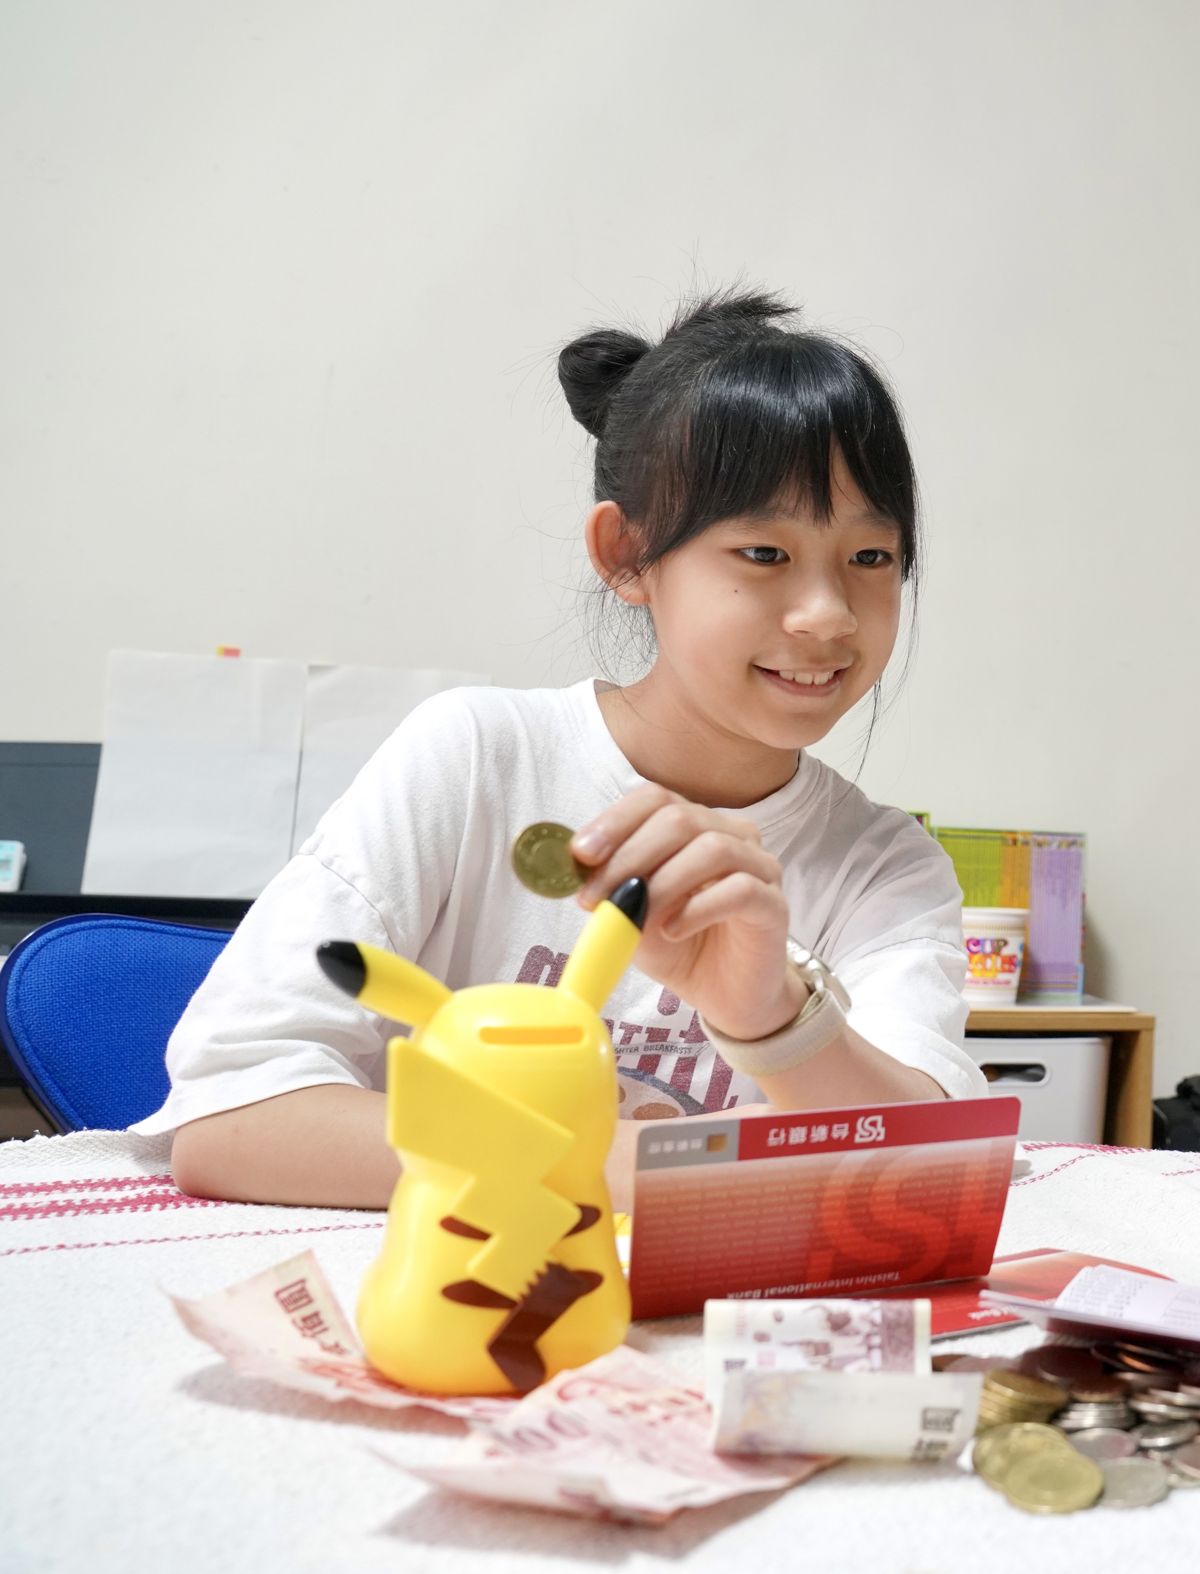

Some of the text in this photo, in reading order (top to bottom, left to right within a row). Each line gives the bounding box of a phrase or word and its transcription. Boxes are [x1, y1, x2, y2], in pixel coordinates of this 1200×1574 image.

[966, 937, 1008, 954] CUP
[766, 1123, 850, 1147] 台新銀行
[764, 1277, 854, 1298] International
[856, 1271, 900, 1285] Taishin
